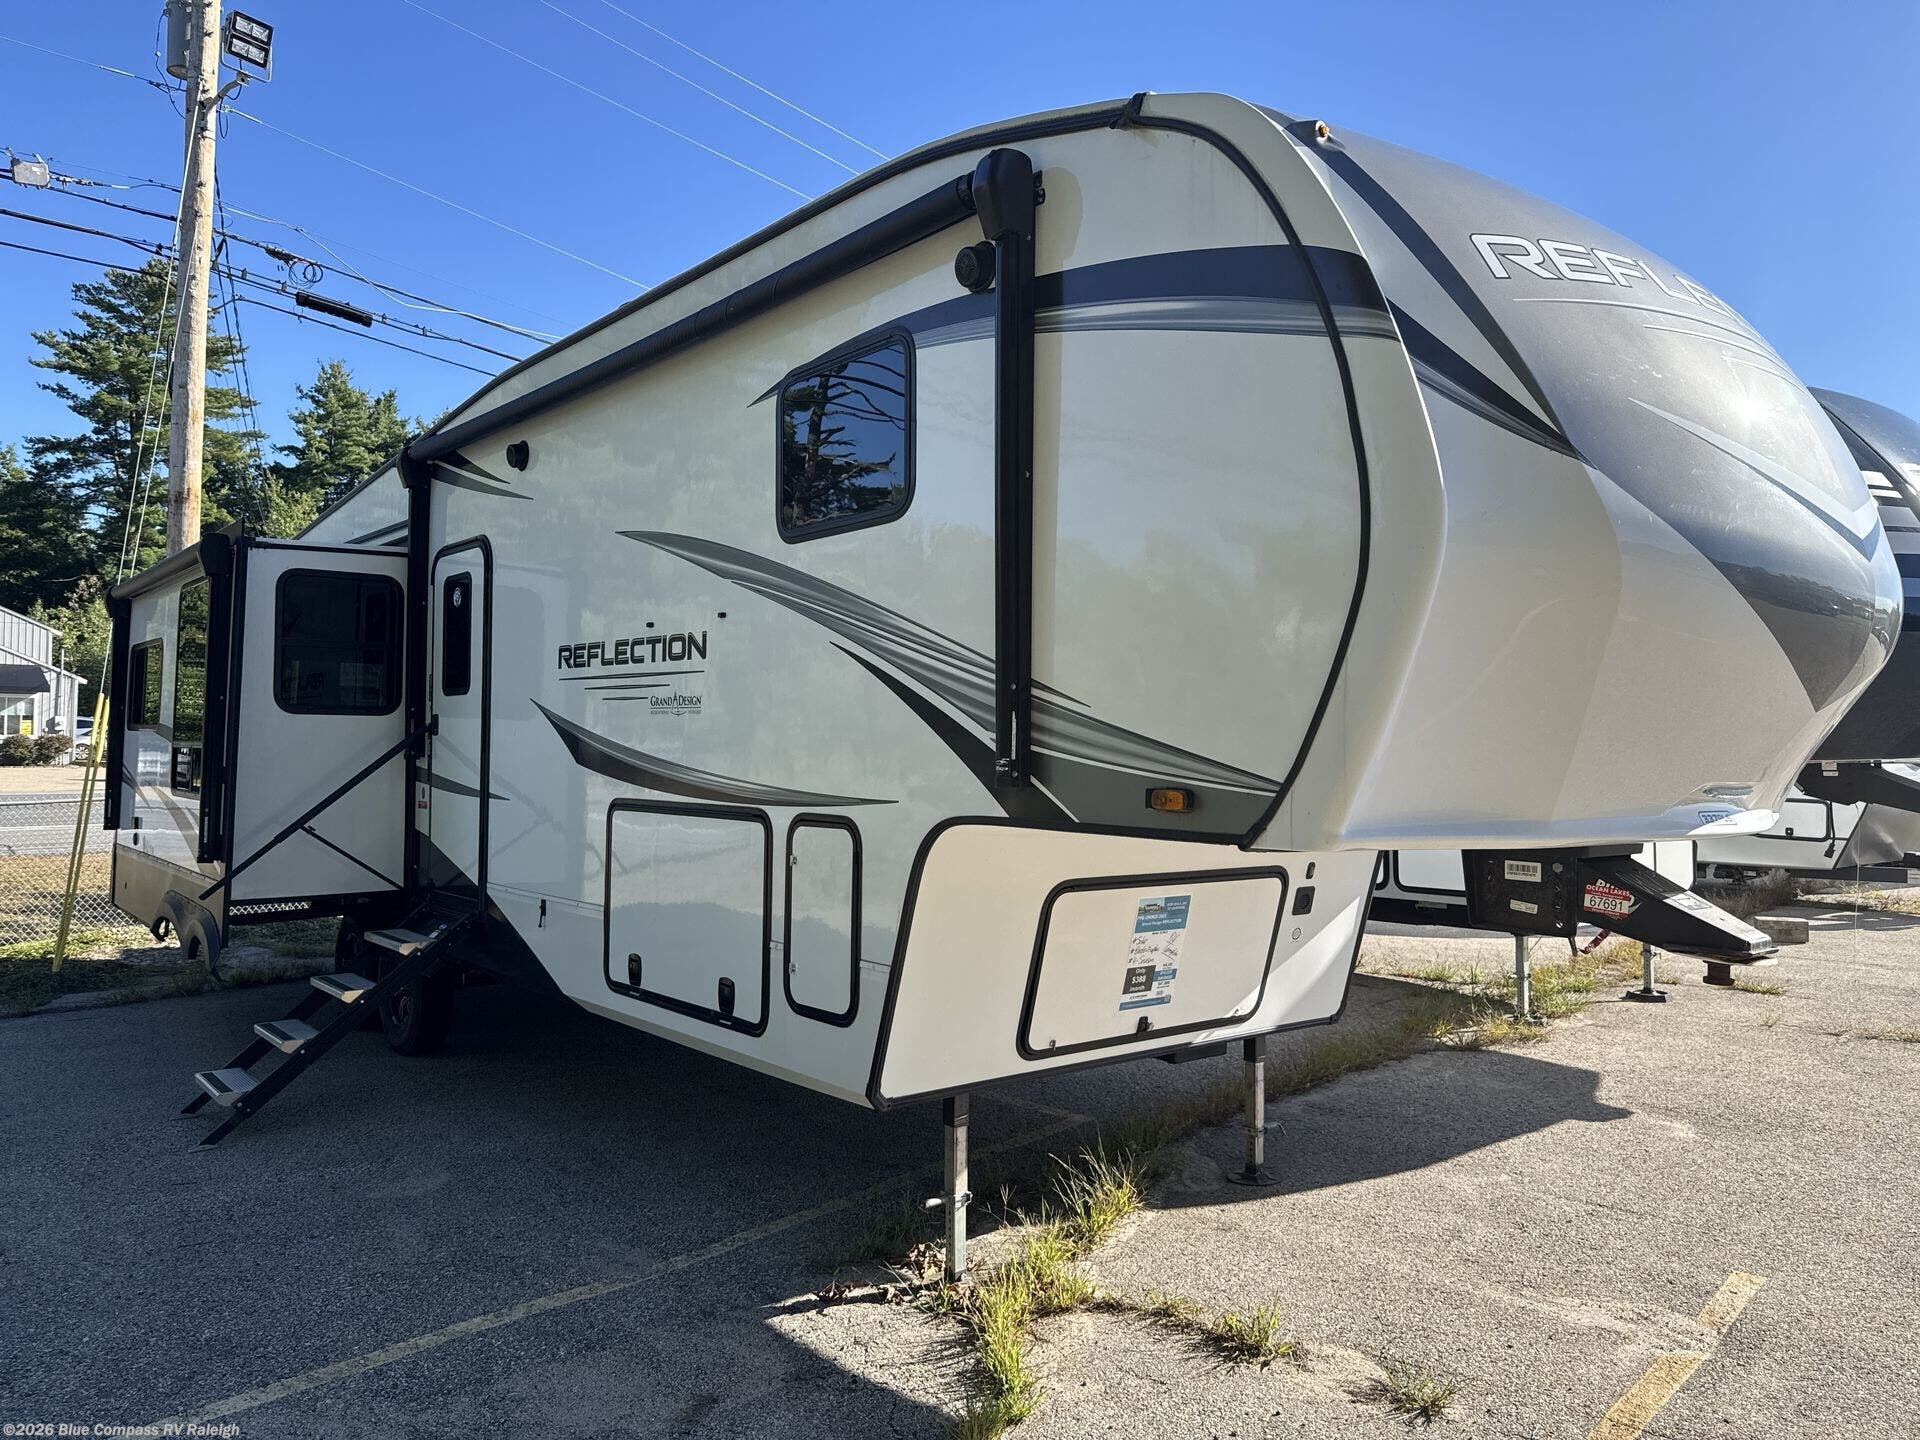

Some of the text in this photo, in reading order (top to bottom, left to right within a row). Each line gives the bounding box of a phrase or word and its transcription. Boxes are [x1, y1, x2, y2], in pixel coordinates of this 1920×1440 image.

[558, 631, 708, 669] REFLECTION
[650, 694, 702, 707] GRAND DESIGN
[1586, 884, 1608, 893] OCEAN
[1610, 887, 1630, 896] LAKES
[1590, 896, 1623, 911] 67691
